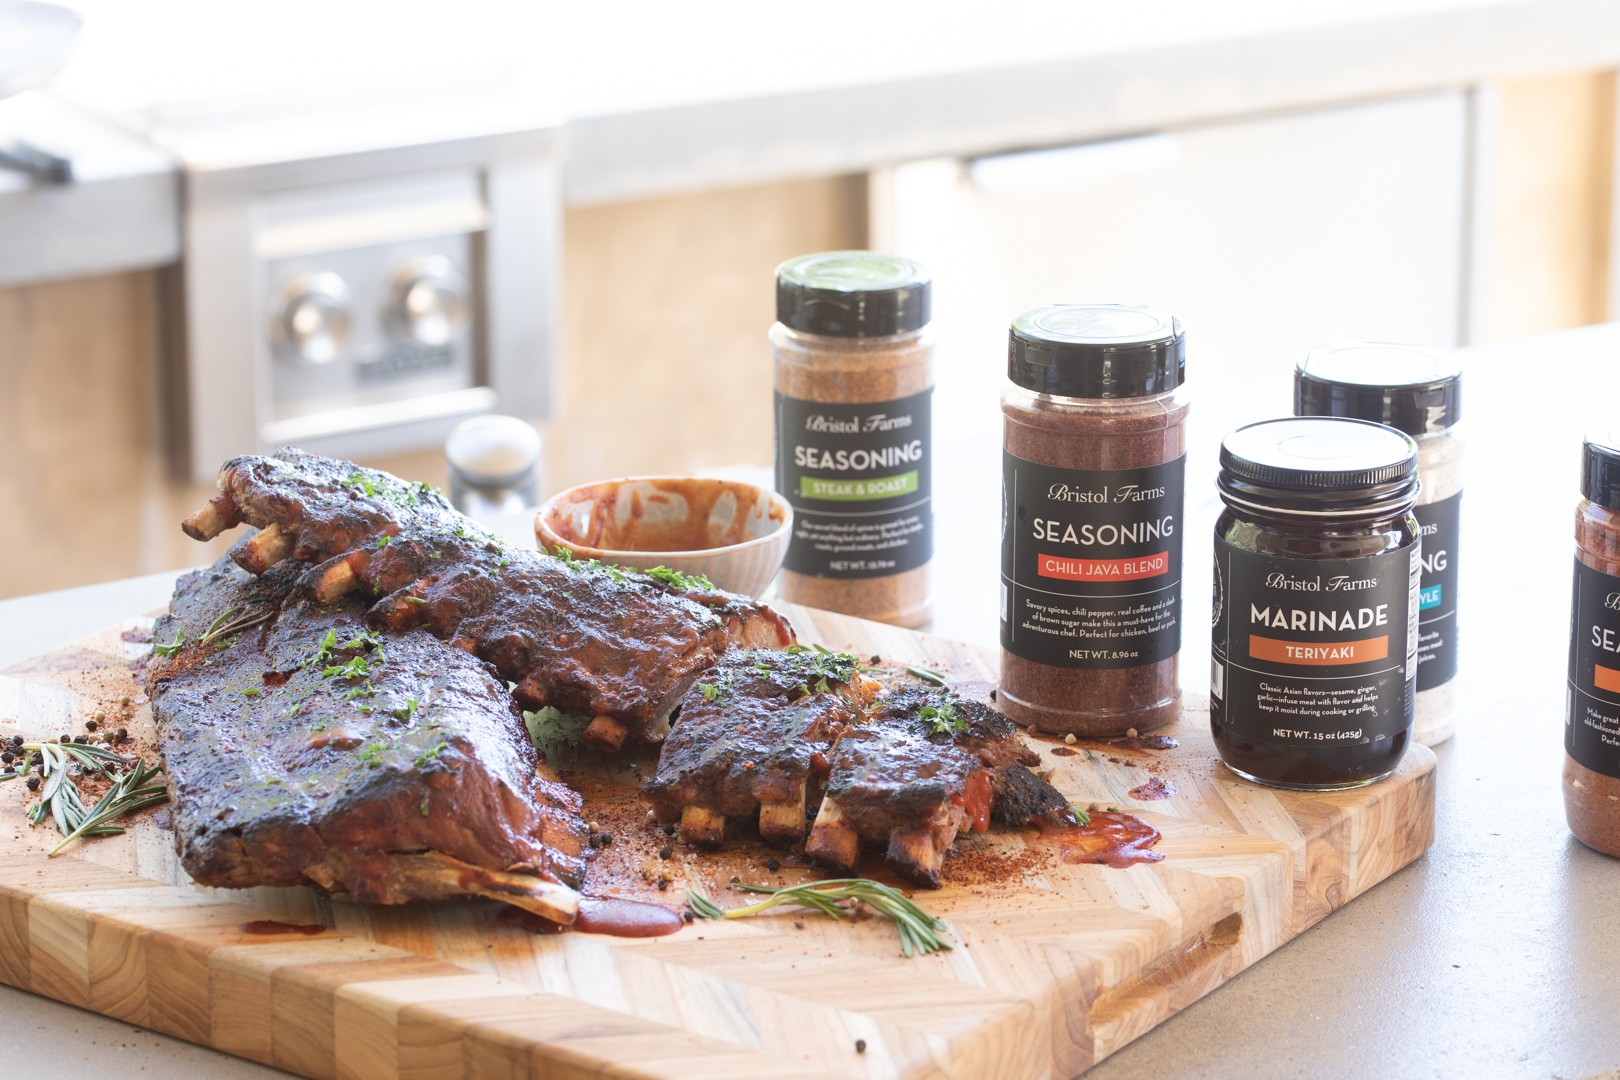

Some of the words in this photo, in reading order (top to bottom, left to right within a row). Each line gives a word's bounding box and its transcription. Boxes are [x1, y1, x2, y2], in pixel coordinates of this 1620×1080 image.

[804, 414, 859, 433] Bristol
[862, 414, 912, 432] Farms
[794, 440, 922, 470] SEASONING
[812, 482, 854, 496] STEAK
[855, 484, 866, 496] &
[866, 478, 908, 494] ROAST
[1047, 483, 1108, 504] Bristol
[1113, 484, 1165, 504] Farms
[1032, 515, 1174, 546] SEASONING
[1046, 560, 1082, 574] CHILI
[1086, 564, 1120, 576] JAVA
[1124, 558, 1163, 575] BLEND
[1265, 572, 1321, 592] Bristol
[1325, 575, 1377, 592] Farms
[1026, 599, 1046, 612] Savory
[1048, 606, 1070, 616] spices,
[1072, 607, 1087, 616] chili
[1088, 610, 1116, 618] pepper,
[1118, 607, 1131, 616] real
[1132, 604, 1151, 614] coffee
[1152, 601, 1162, 610] and
[1250, 602, 1388, 632] MARINADE
[1022, 620, 1059, 636] adventurous
[1060, 629, 1078, 638] chef.
[1079, 629, 1107, 638] Perfect
[1108, 629, 1119, 638] for
[1120, 626, 1147, 637] chicken,
[1148, 623, 1161, 634] beef
[1032, 612, 1038, 620] of
[1040, 613, 1060, 624] brown
[1061, 618, 1080, 628] sugar
[1081, 619, 1101, 627] make
[1103, 618, 1115, 627] this
[1122, 615, 1154, 626] must-have
[1069, 650, 1090, 659] NET
[1091, 650, 1111, 659] WT.
[1112, 650, 1130, 659] 8.96
[1286, 645, 1354, 659] TERIYAKI
[1260, 682, 1282, 693] Classic
[1283, 686, 1302, 695] Asian
[1357, 685, 1377, 695] ginger,
[1317, 697, 1332, 705] with
[1332, 697, 1351, 705] flavor
[1352, 694, 1363, 704] and
[1364, 693, 1379, 703] helps
[1258, 701, 1274, 712] keep
[1299, 707, 1321, 717] during
[1322, 707, 1347, 717] cooking
[1587, 706, 1602, 719] Make
[1602, 715, 1620, 724] great
[1273, 728, 1292, 738] NET
[1294, 731, 1312, 739] WT.
[1337, 728, 1362, 740] (425g)
[1602, 734, 1620, 746] Perfe
